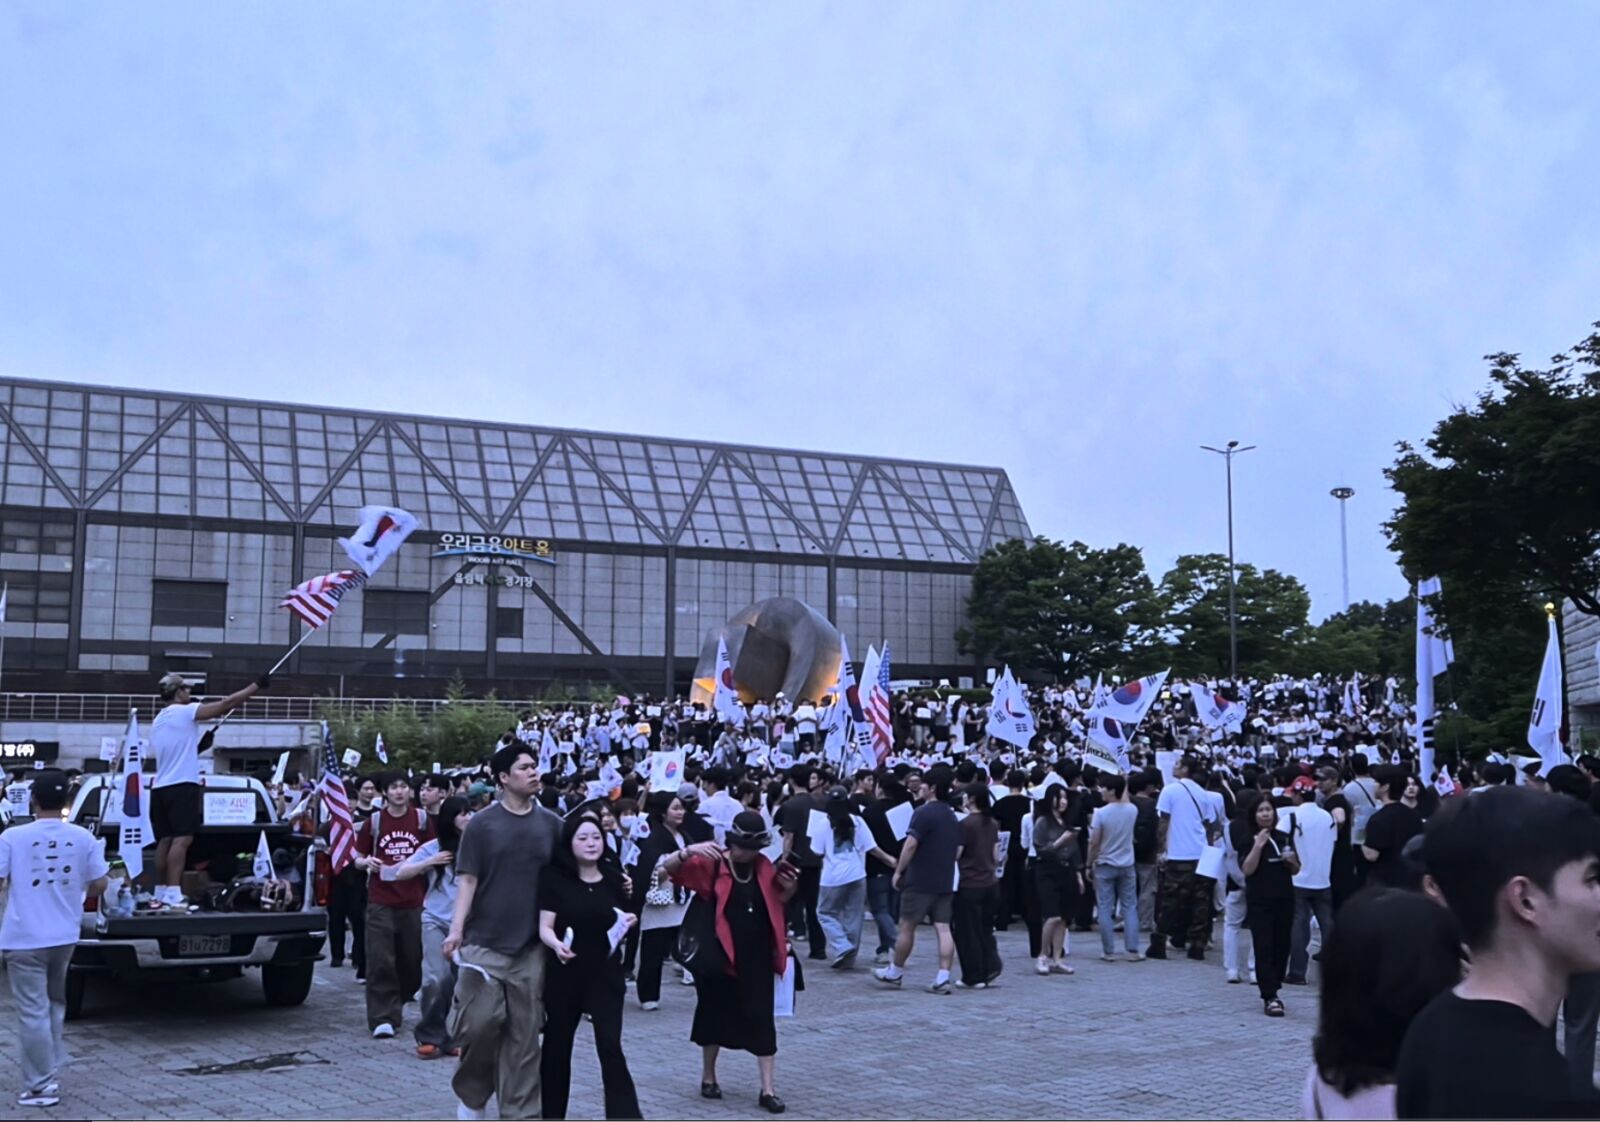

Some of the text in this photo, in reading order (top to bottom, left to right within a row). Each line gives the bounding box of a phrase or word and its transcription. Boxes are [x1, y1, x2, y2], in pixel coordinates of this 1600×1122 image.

[438, 533, 550, 556] 우리금융아트홀
[379, 831, 420, 848] NEW BALANCE
